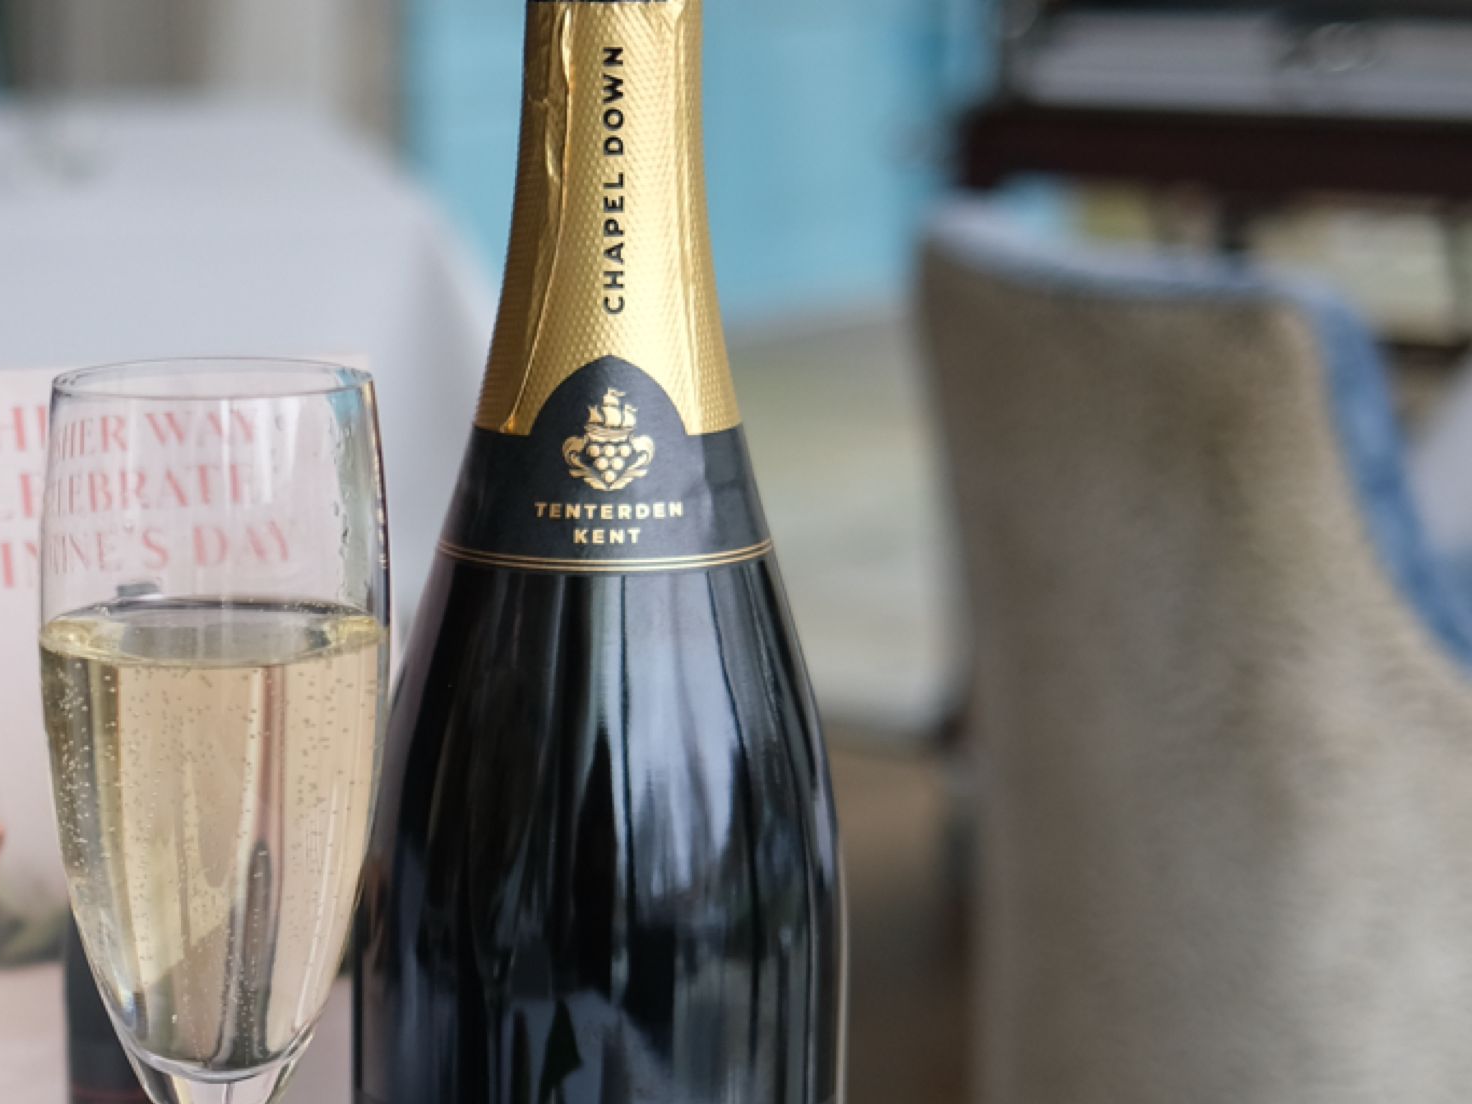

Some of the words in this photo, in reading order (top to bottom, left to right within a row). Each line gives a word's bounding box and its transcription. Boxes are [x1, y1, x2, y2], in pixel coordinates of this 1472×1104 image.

[602, 46, 625, 156] DOWN
[602, 172, 625, 314] CHAPEL
[534, 502, 684, 521] TENTERDEN
[572, 527, 641, 545] KENT
